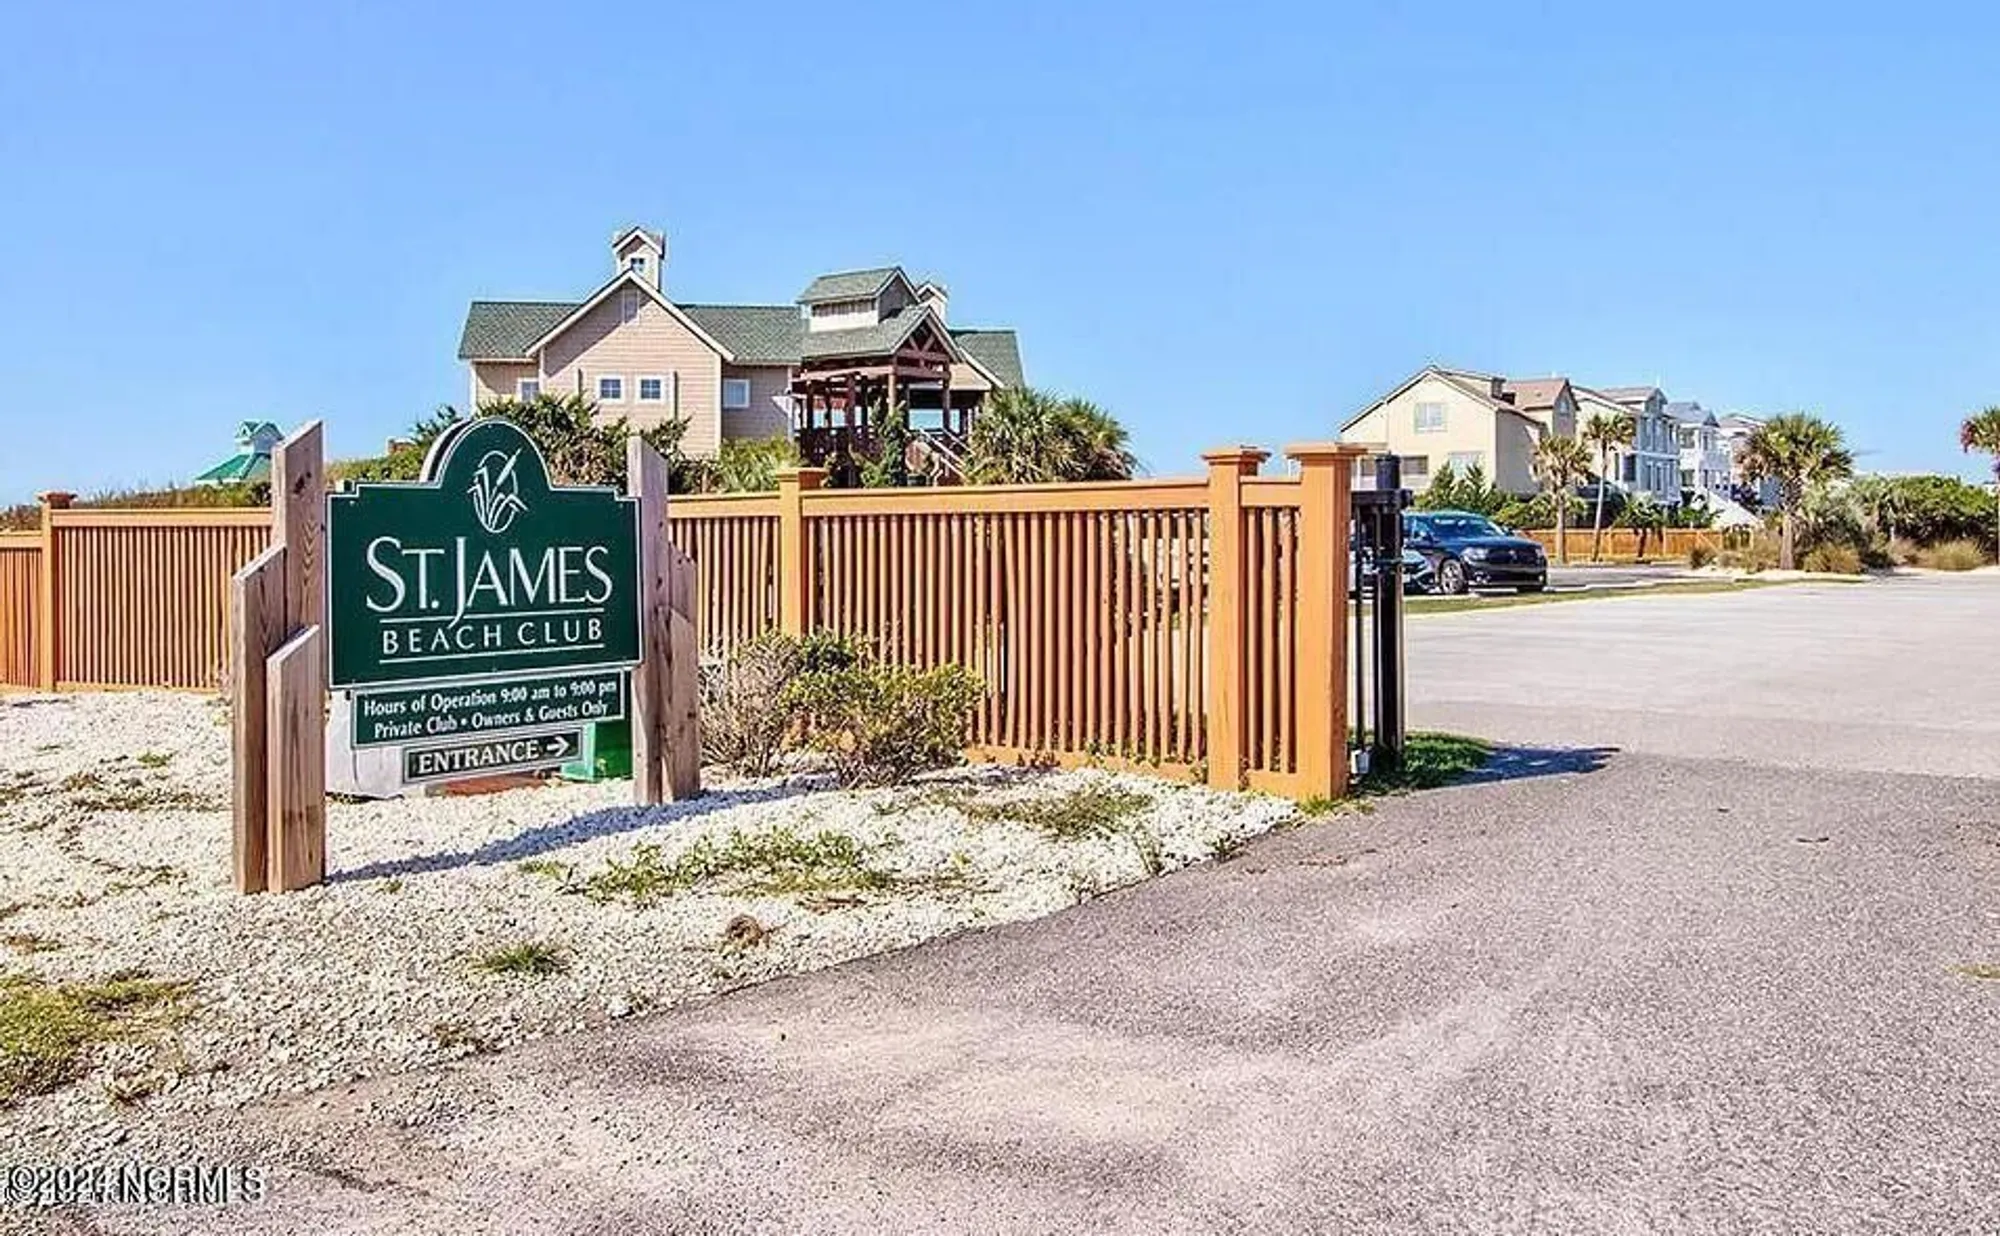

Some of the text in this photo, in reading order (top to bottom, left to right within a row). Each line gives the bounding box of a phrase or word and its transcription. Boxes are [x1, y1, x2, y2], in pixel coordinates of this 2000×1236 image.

[366, 536, 613, 628] ST. JAMES
[383, 617, 602, 655] BEACH CLUB
[364, 680, 617, 717] Hours of Operation 9:00 am to 9:00 pm
[374, 699, 609, 739] Private Club Owners & Guests Only
[417, 738, 539, 775] ENTRANCE
